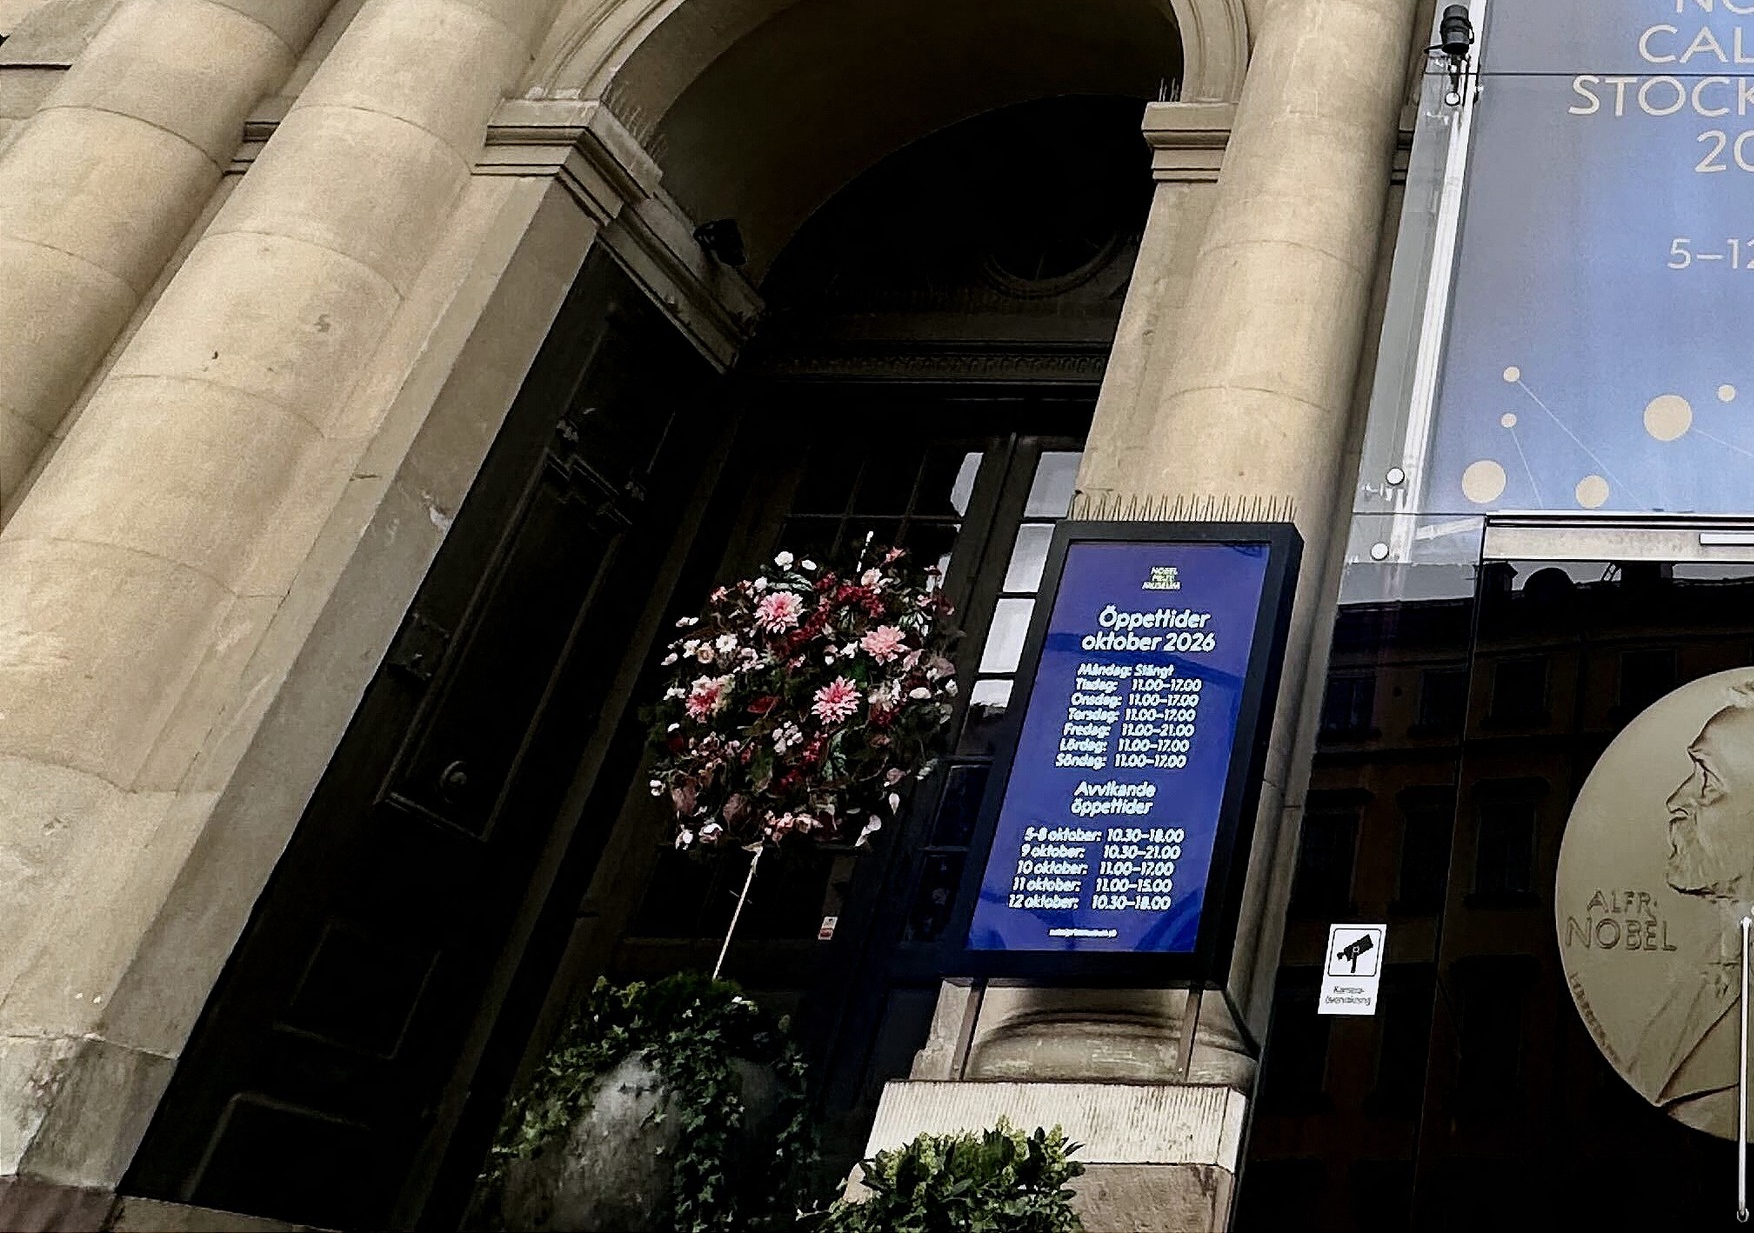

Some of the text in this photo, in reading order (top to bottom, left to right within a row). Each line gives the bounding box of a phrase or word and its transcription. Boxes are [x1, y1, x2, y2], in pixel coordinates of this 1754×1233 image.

[1099, 604, 1211, 632] Öppettider
[1082, 631, 1216, 652] oktober 2026
[1074, 781, 1156, 797] Avvikande
[1071, 797, 1153, 817] öppettider
[1021, 844, 1030, 857] 9
[1017, 860, 1033, 875] 10
[1012, 877, 1026, 891] 11
[1009, 894, 1024, 908] 12
[1565, 916, 1678, 952] NOBEL
